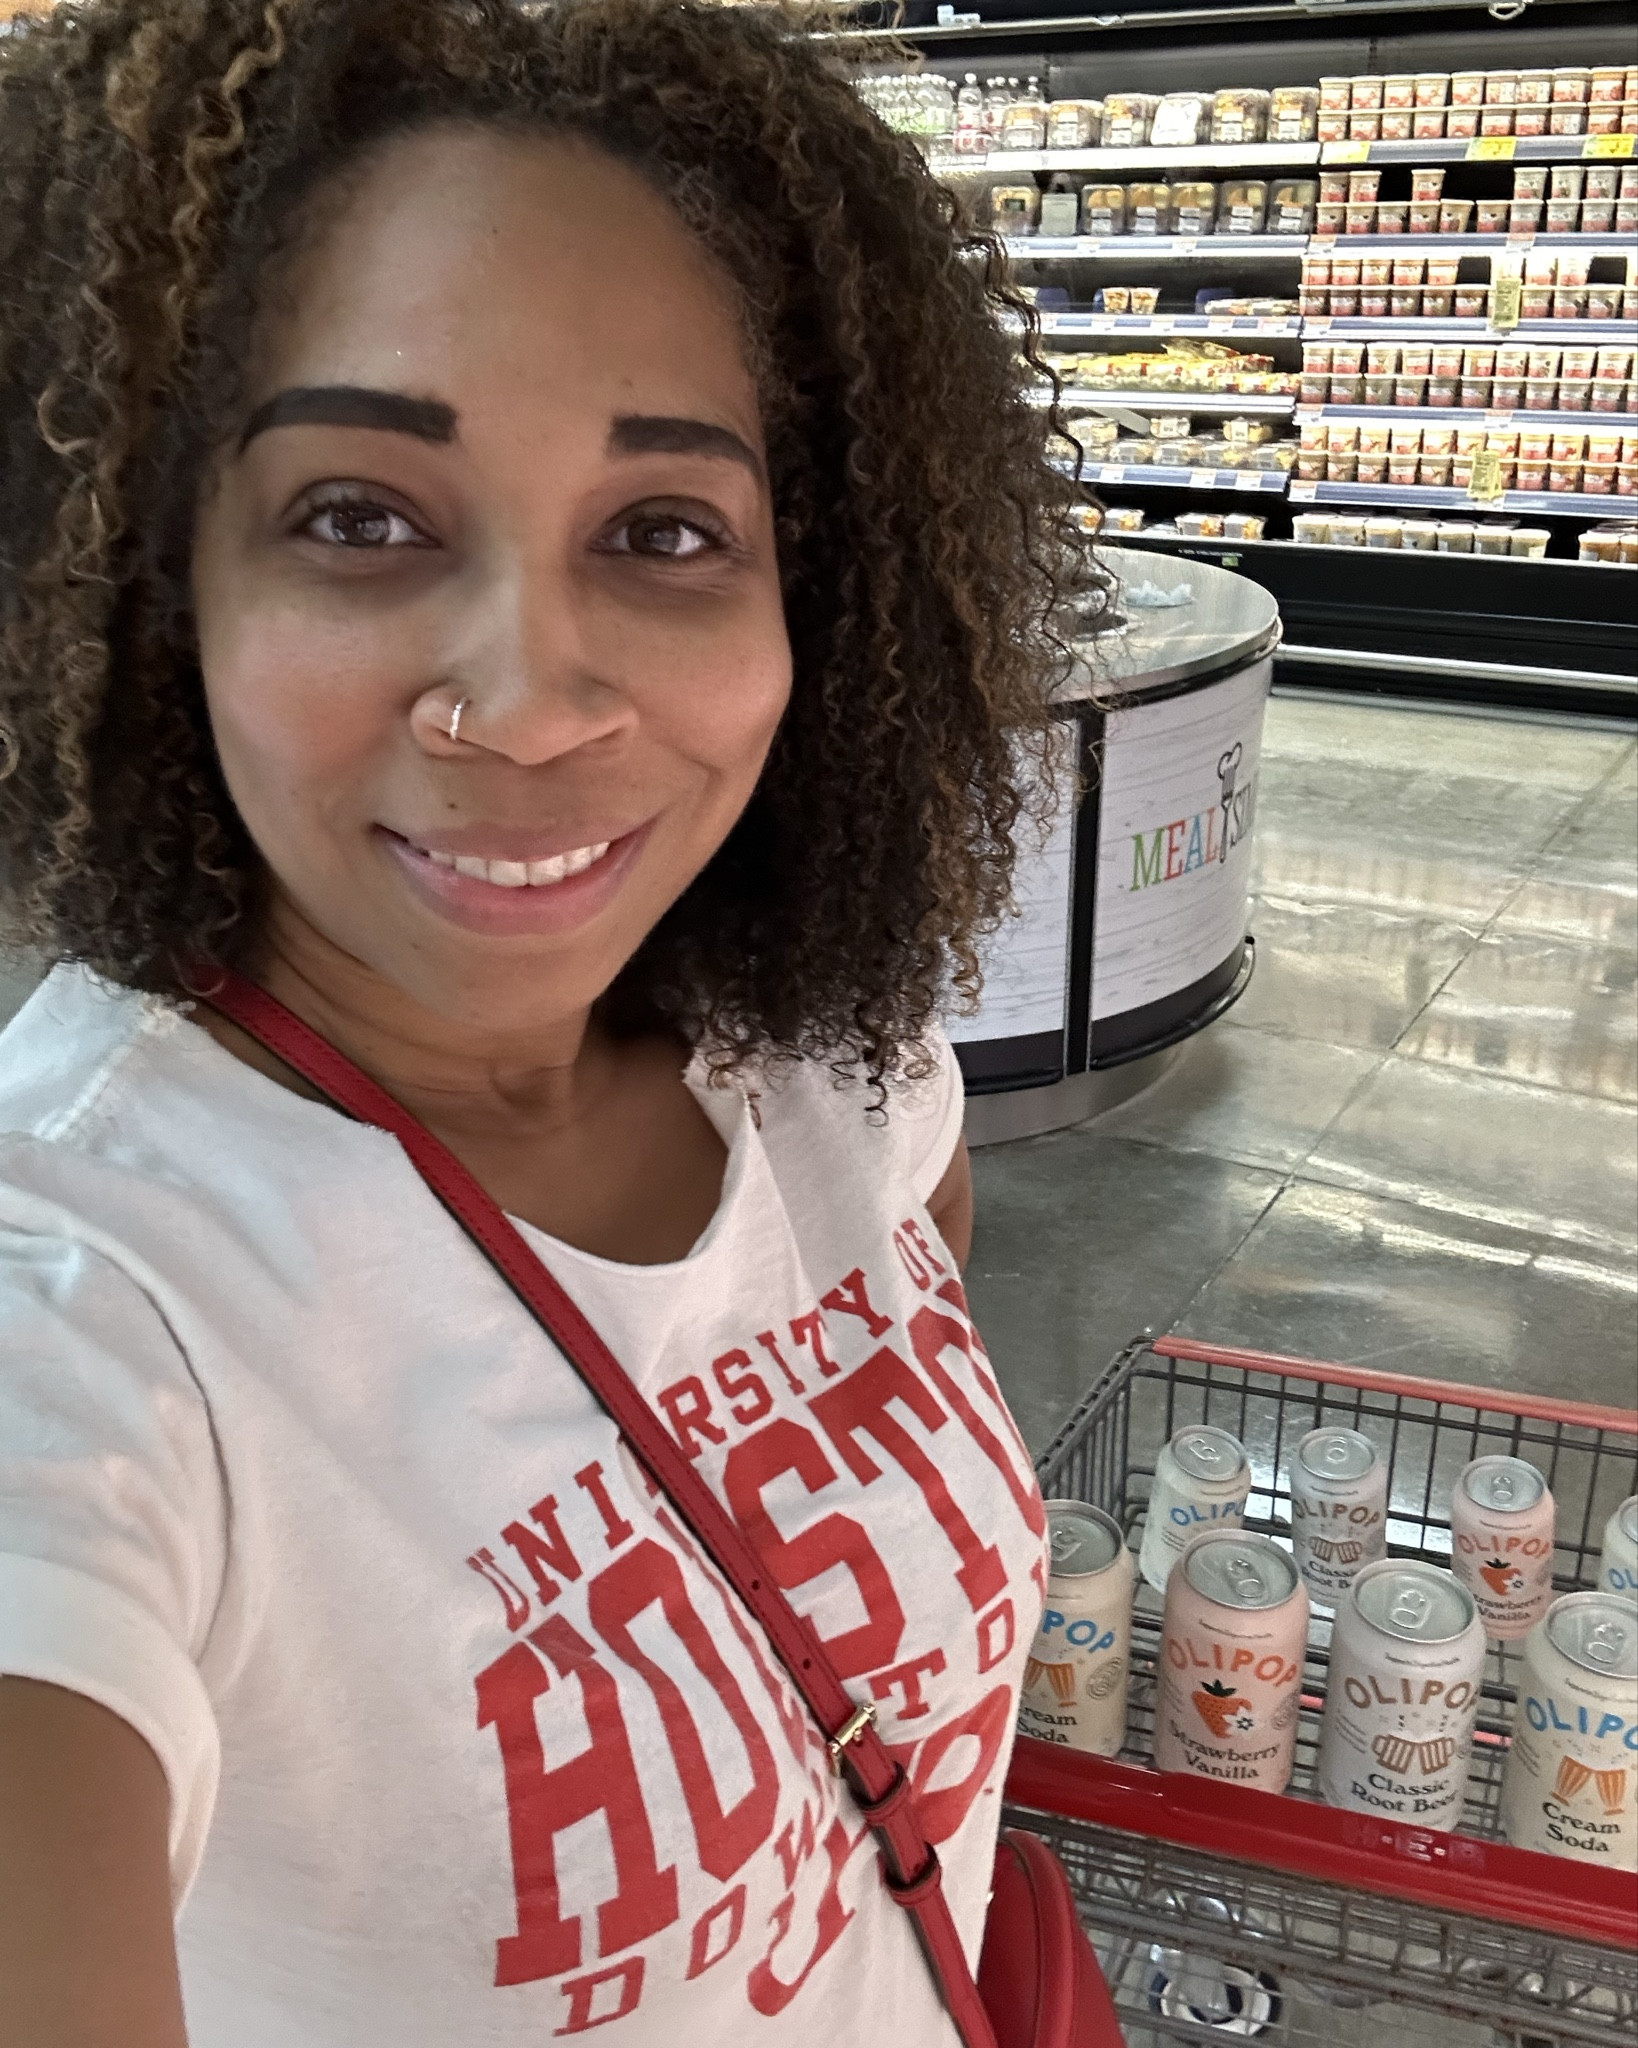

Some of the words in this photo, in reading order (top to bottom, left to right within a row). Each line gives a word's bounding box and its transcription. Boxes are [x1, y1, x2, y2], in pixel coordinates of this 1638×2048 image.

[1129, 806, 1218, 892] MEAL
[466, 1267, 894, 1633] UNIRSITY
[893, 1218, 946, 1291] OF
[1477, 1604, 1531, 1621] Vanilla
[1168, 1637, 1298, 1688] OLIPOP
[1019, 1705, 1078, 1726] ream
[1168, 1718, 1281, 1762] Strawberry
[1184, 1748, 1260, 1780] Vanilla
[1351, 1780, 1406, 1812] Root
[1368, 1773, 1450, 1796] Classic
[1542, 1802, 1622, 1834] Cream
[1545, 1823, 1611, 1853] Soda
